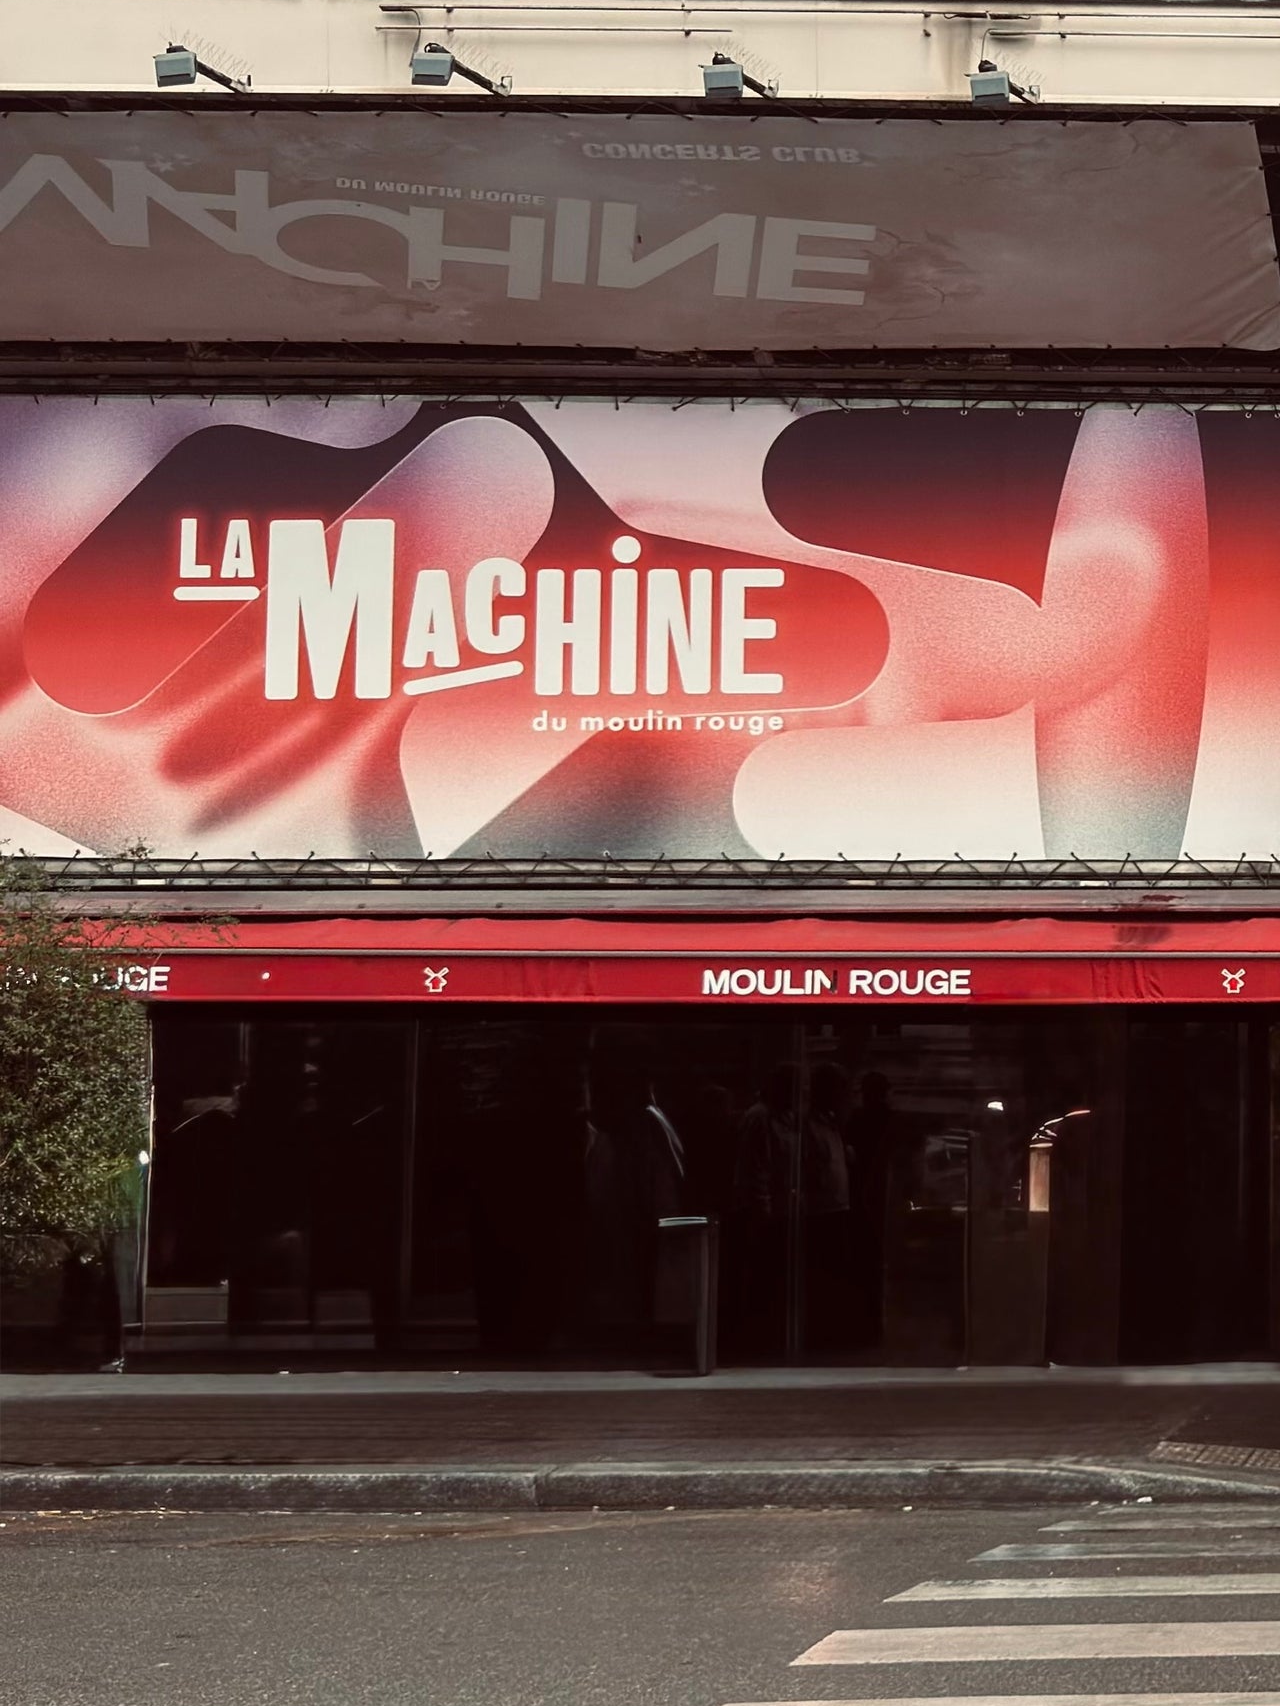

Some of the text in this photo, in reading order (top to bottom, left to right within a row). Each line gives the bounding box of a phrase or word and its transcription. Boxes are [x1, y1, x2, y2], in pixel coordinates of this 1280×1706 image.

[180, 517, 255, 580] LA
[532, 709, 785, 736] du moulin rouge
[702, 969, 972, 995] MOULIN ROUGE
